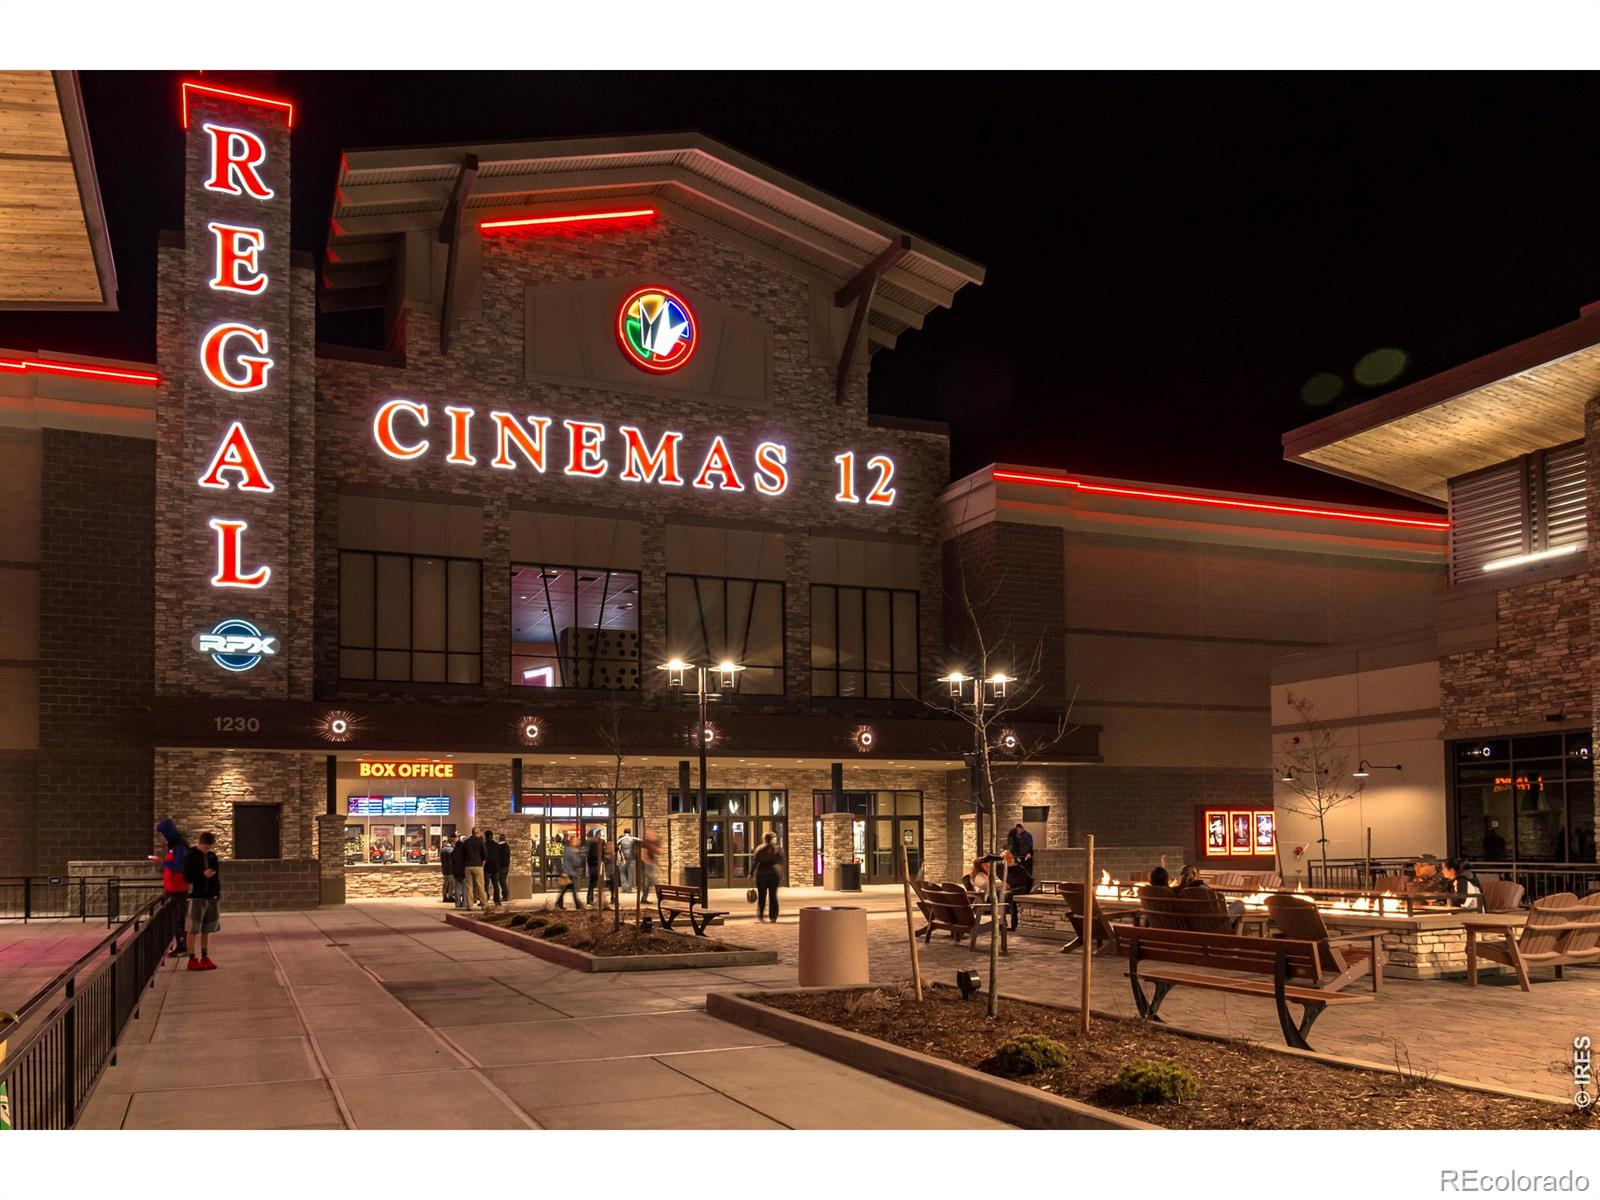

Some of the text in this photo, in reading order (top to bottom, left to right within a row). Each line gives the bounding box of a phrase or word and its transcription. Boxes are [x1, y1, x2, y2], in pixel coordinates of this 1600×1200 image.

[198, 122, 275, 589] REGAL
[373, 399, 897, 506] CINEMAS 12
[199, 634, 276, 654] RPX
[214, 716, 260, 732] 1230
[359, 762, 454, 778] BOX OFFICE
